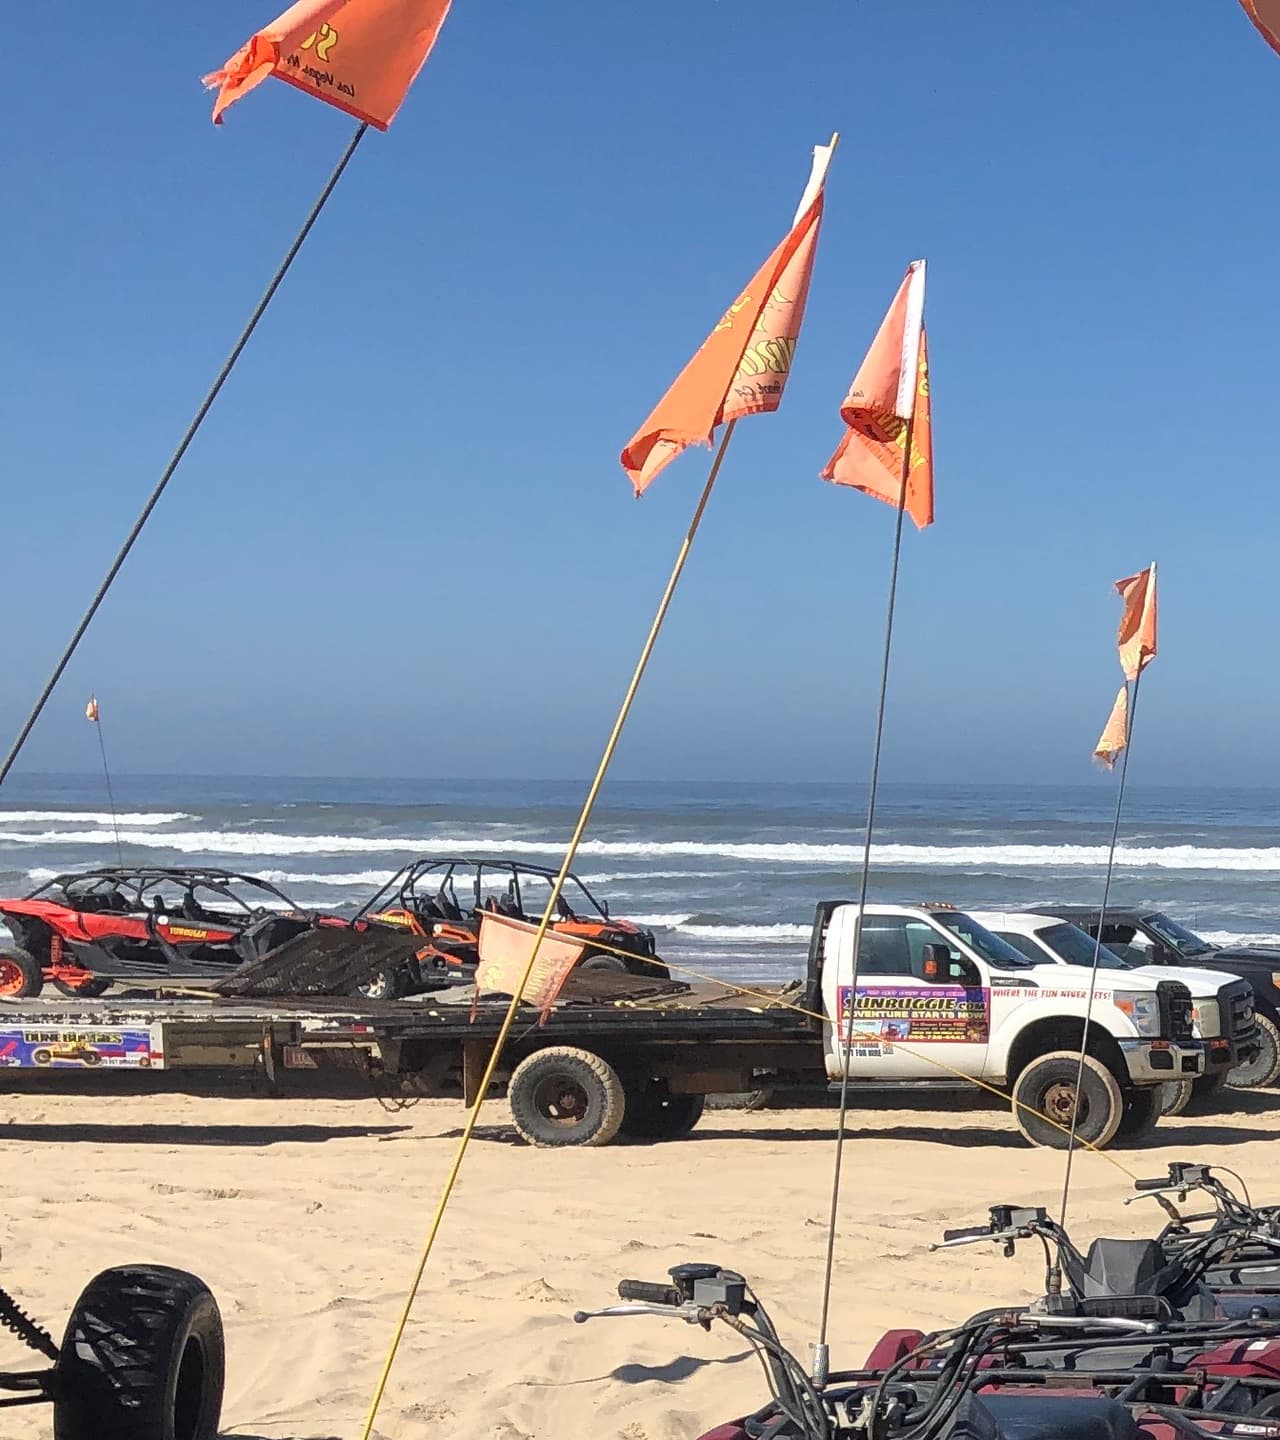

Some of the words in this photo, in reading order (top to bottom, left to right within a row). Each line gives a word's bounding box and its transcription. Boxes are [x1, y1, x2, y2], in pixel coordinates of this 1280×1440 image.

[993, 989, 1020, 998] WHERE
[1024, 990, 1038, 998] THE
[1041, 990, 1057, 998] FUN
[1061, 991, 1087, 999] NEVER
